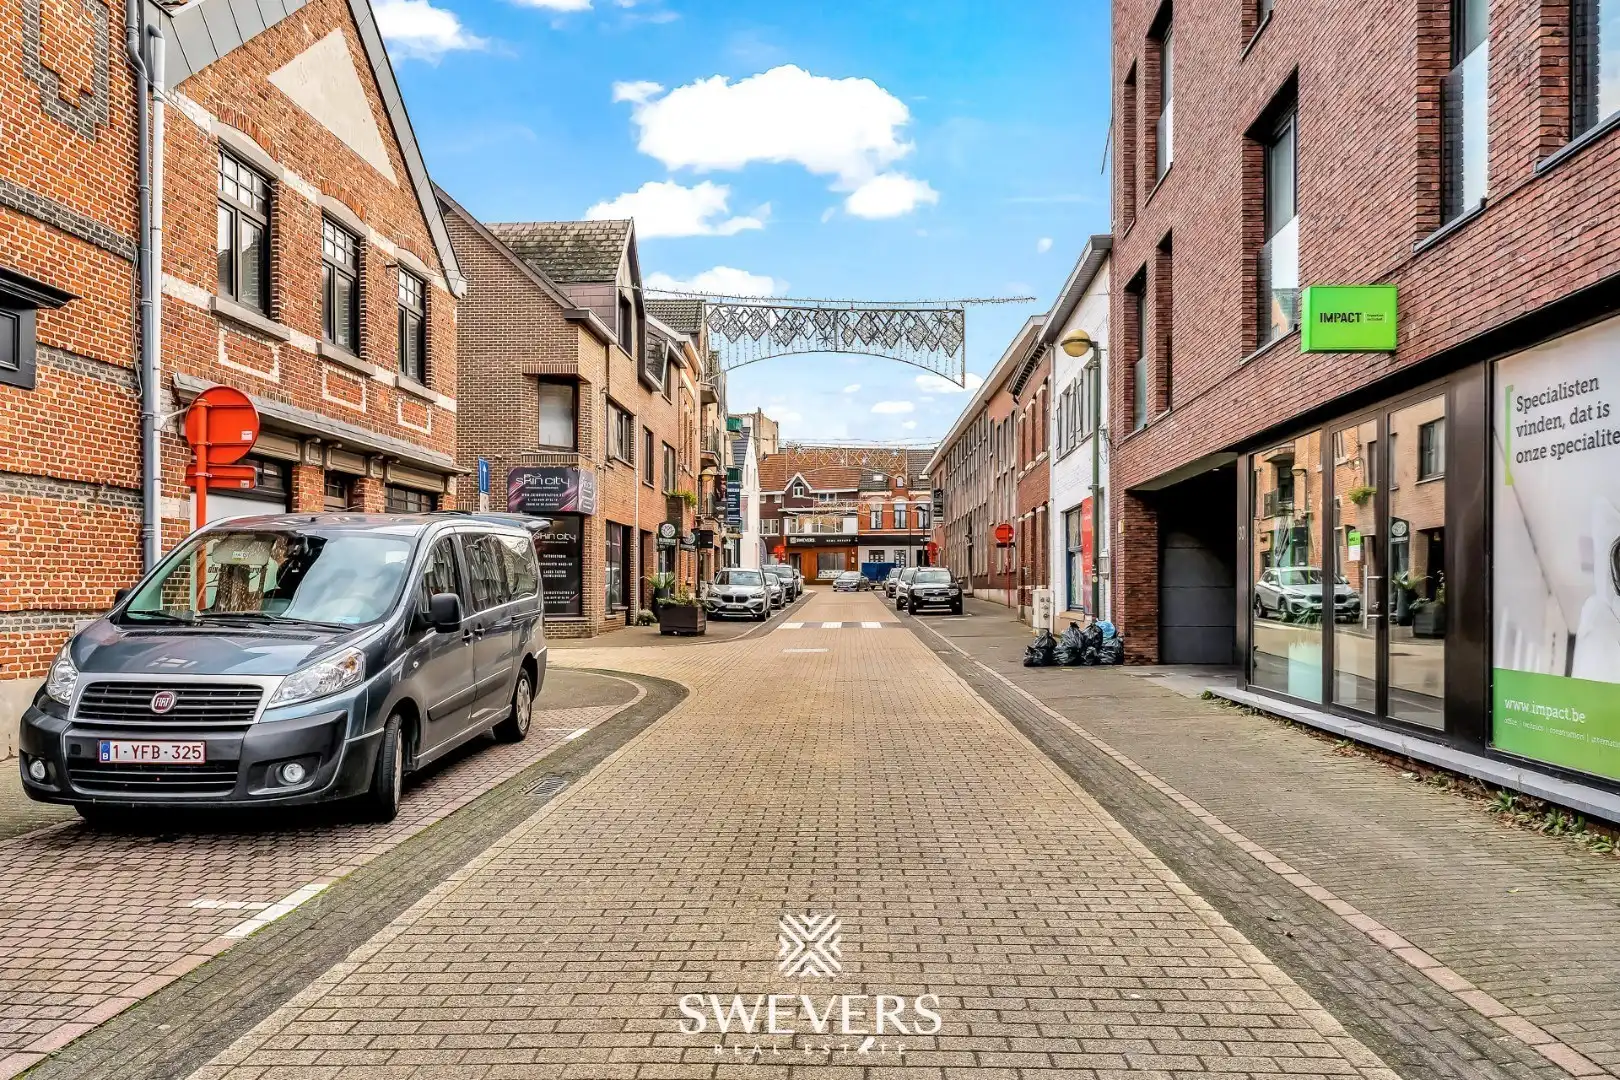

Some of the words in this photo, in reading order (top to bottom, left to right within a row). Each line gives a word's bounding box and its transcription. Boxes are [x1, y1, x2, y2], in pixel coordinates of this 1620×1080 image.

[1319, 312, 1362, 323] IMPACT
[1516, 377, 1599, 414] Specialisten
[1516, 415, 1566, 438] vinden,
[1569, 406, 1593, 425] dat
[1596, 400, 1610, 419] is
[1516, 446, 1547, 464] onze
[155, 697, 170, 707] FIAT
[1504, 699, 1586, 724] www.impact.be
[102, 752, 109, 760] B
[113, 744, 202, 760] 1-YFB-325
